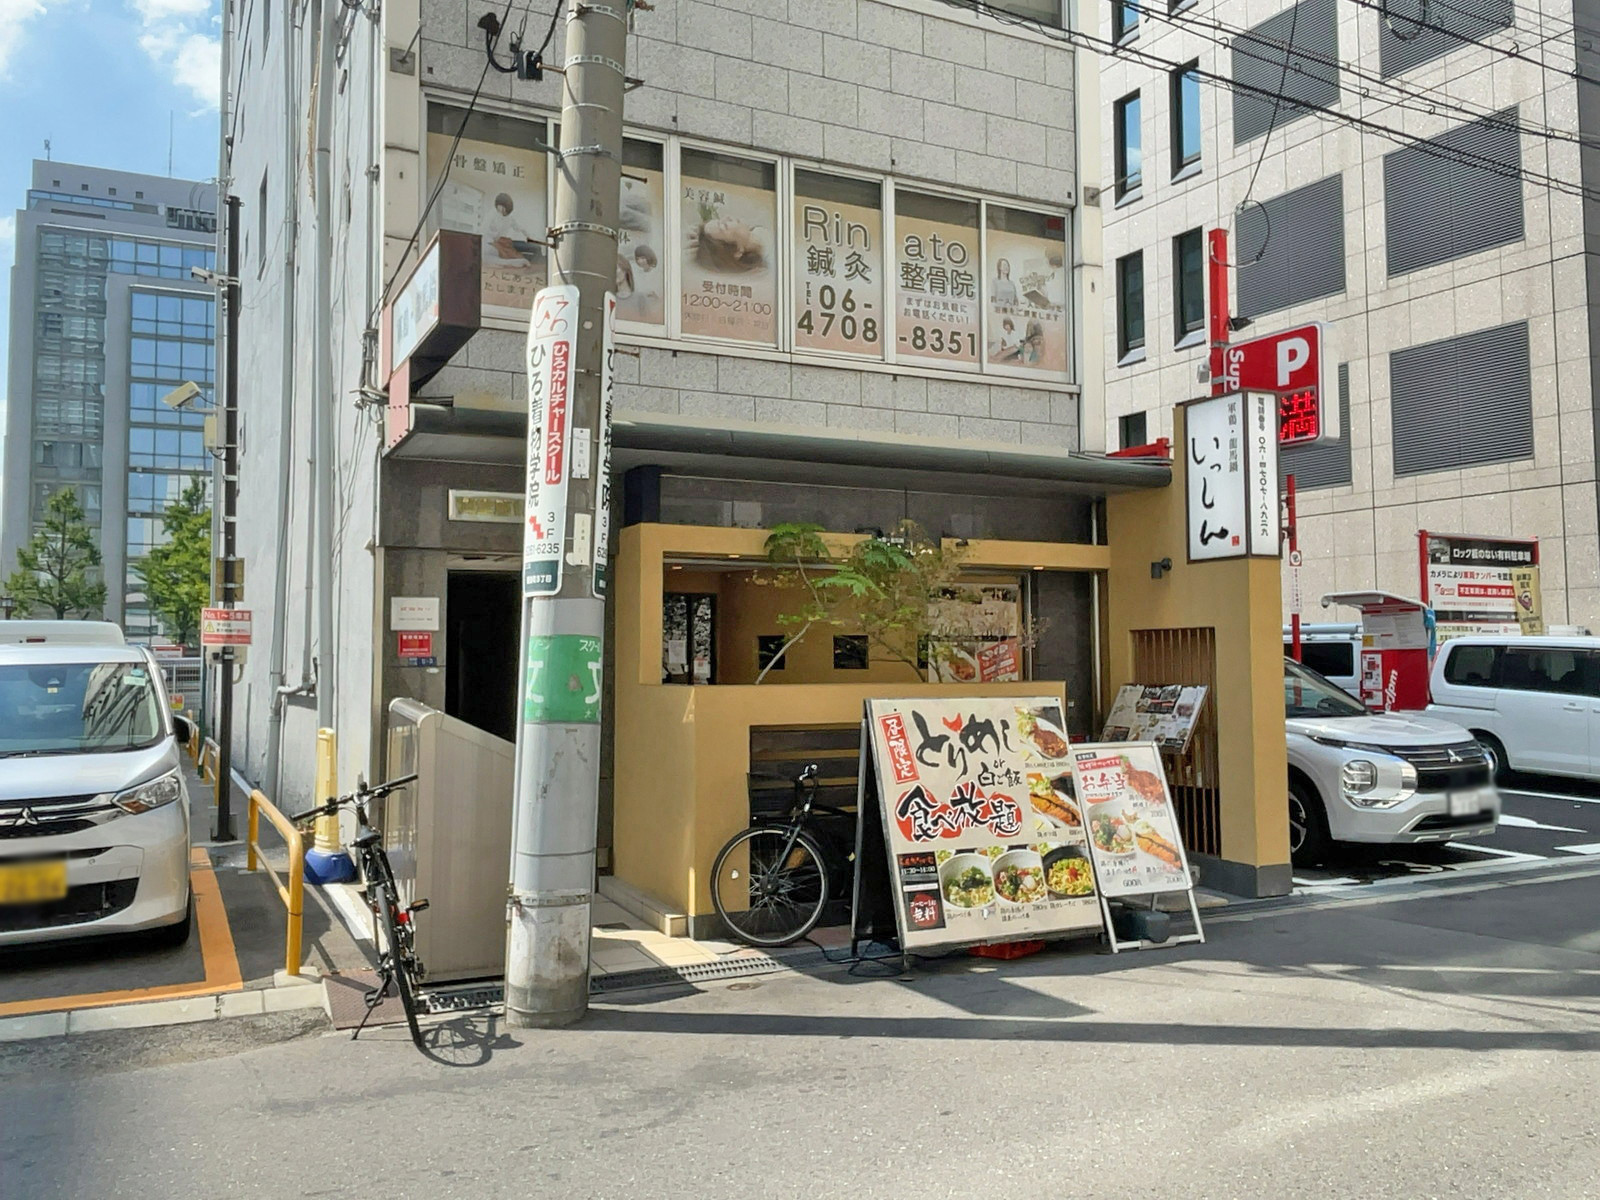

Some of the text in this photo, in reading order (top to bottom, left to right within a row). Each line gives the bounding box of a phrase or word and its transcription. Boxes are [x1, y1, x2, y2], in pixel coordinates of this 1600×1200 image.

[803, 205, 868, 248] Rin
[806, 245, 871, 283] 鍼灸
[904, 233, 967, 265] ato
[702, 280, 753, 299] 受付時間
[900, 262, 975, 299] 整骨院
[797, 309, 878, 343] 4708
[898, 325, 976, 357] -8351
[1277, 336, 1310, 387] P
[546, 343, 568, 482] ひろカルチャースクール
[911, 710, 1018, 781] とりめし
[978, 762, 1022, 788] 白ご飯
[1081, 772, 1126, 792] お弁当
[896, 783, 1021, 842] 食べ放題
